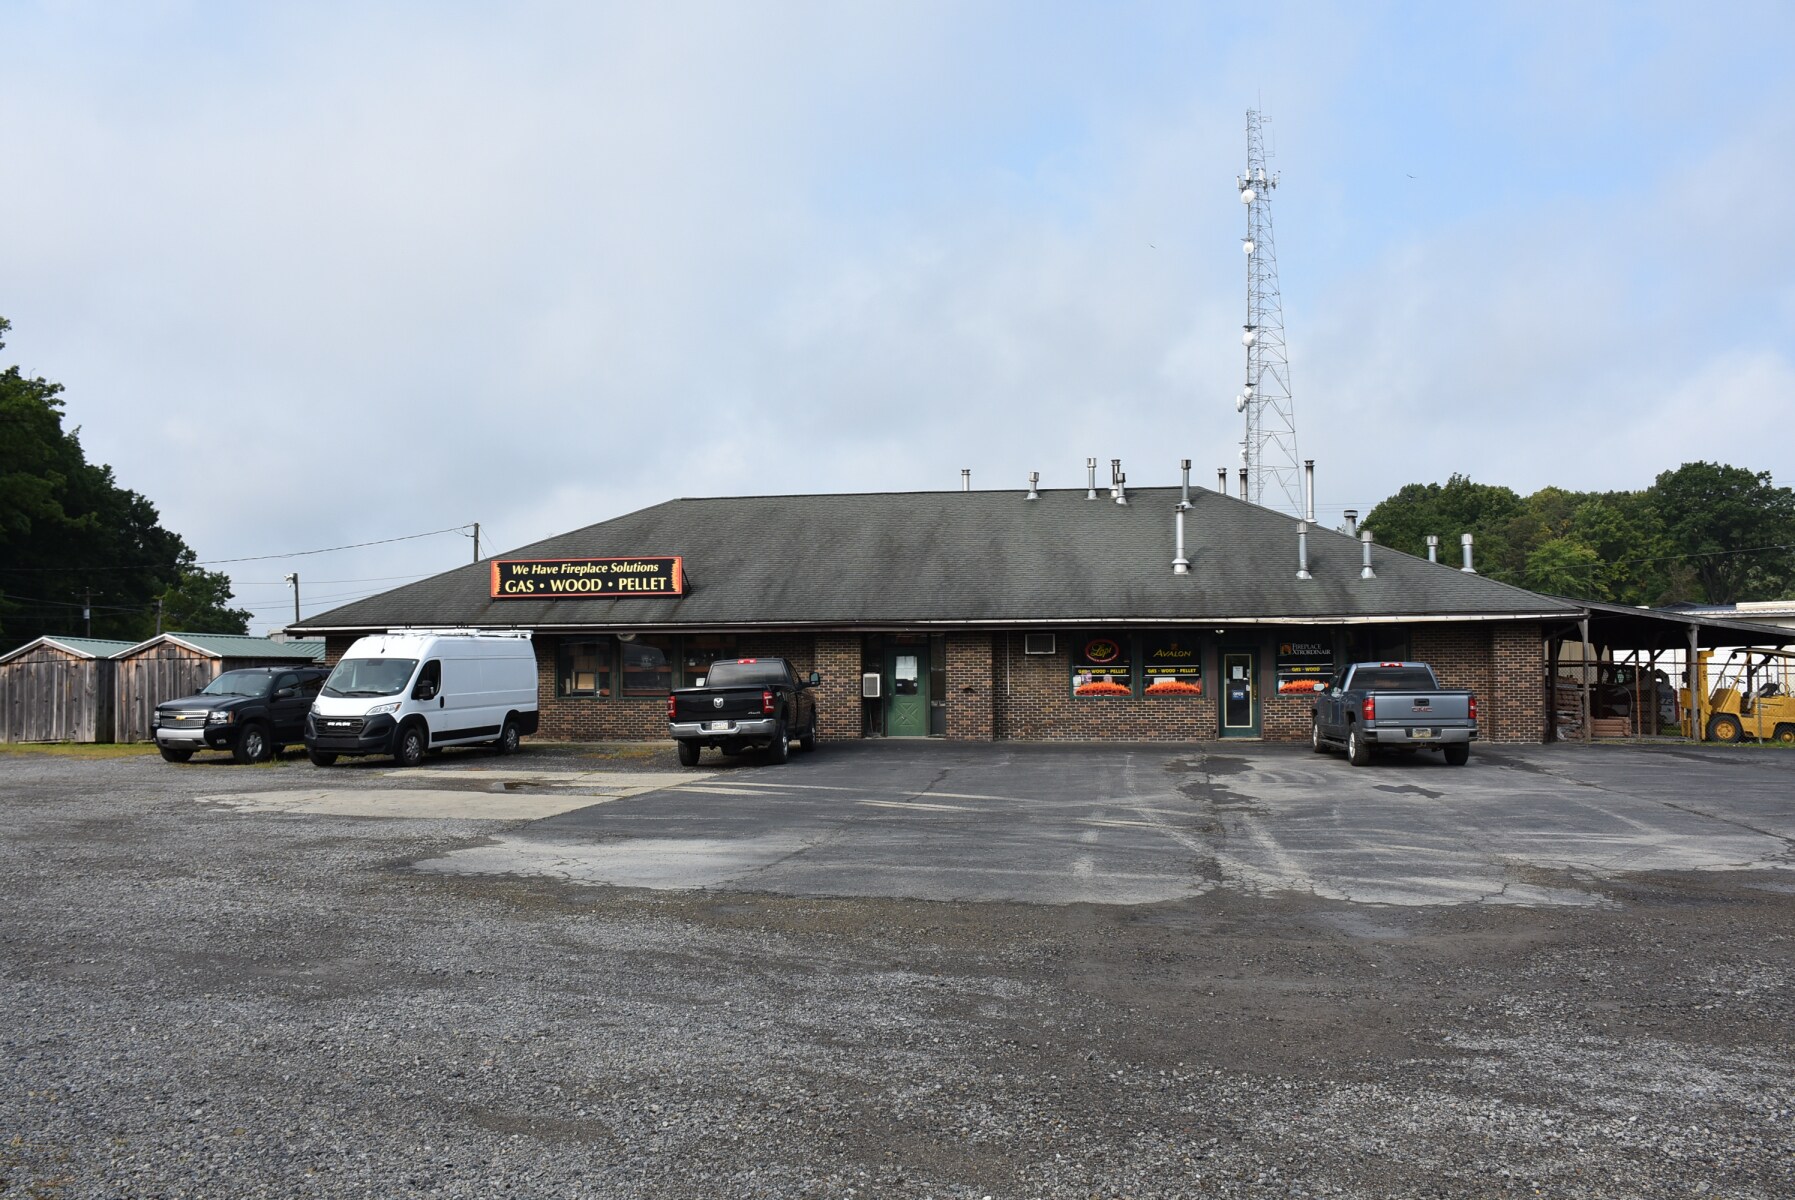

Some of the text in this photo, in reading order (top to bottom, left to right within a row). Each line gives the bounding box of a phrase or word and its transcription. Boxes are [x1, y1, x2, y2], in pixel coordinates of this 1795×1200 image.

[512, 561, 659, 576] We Have Fireplace Solutions
[504, 577, 667, 593] GAS WOOD PELLET
[1153, 649, 1192, 657] AVALON
